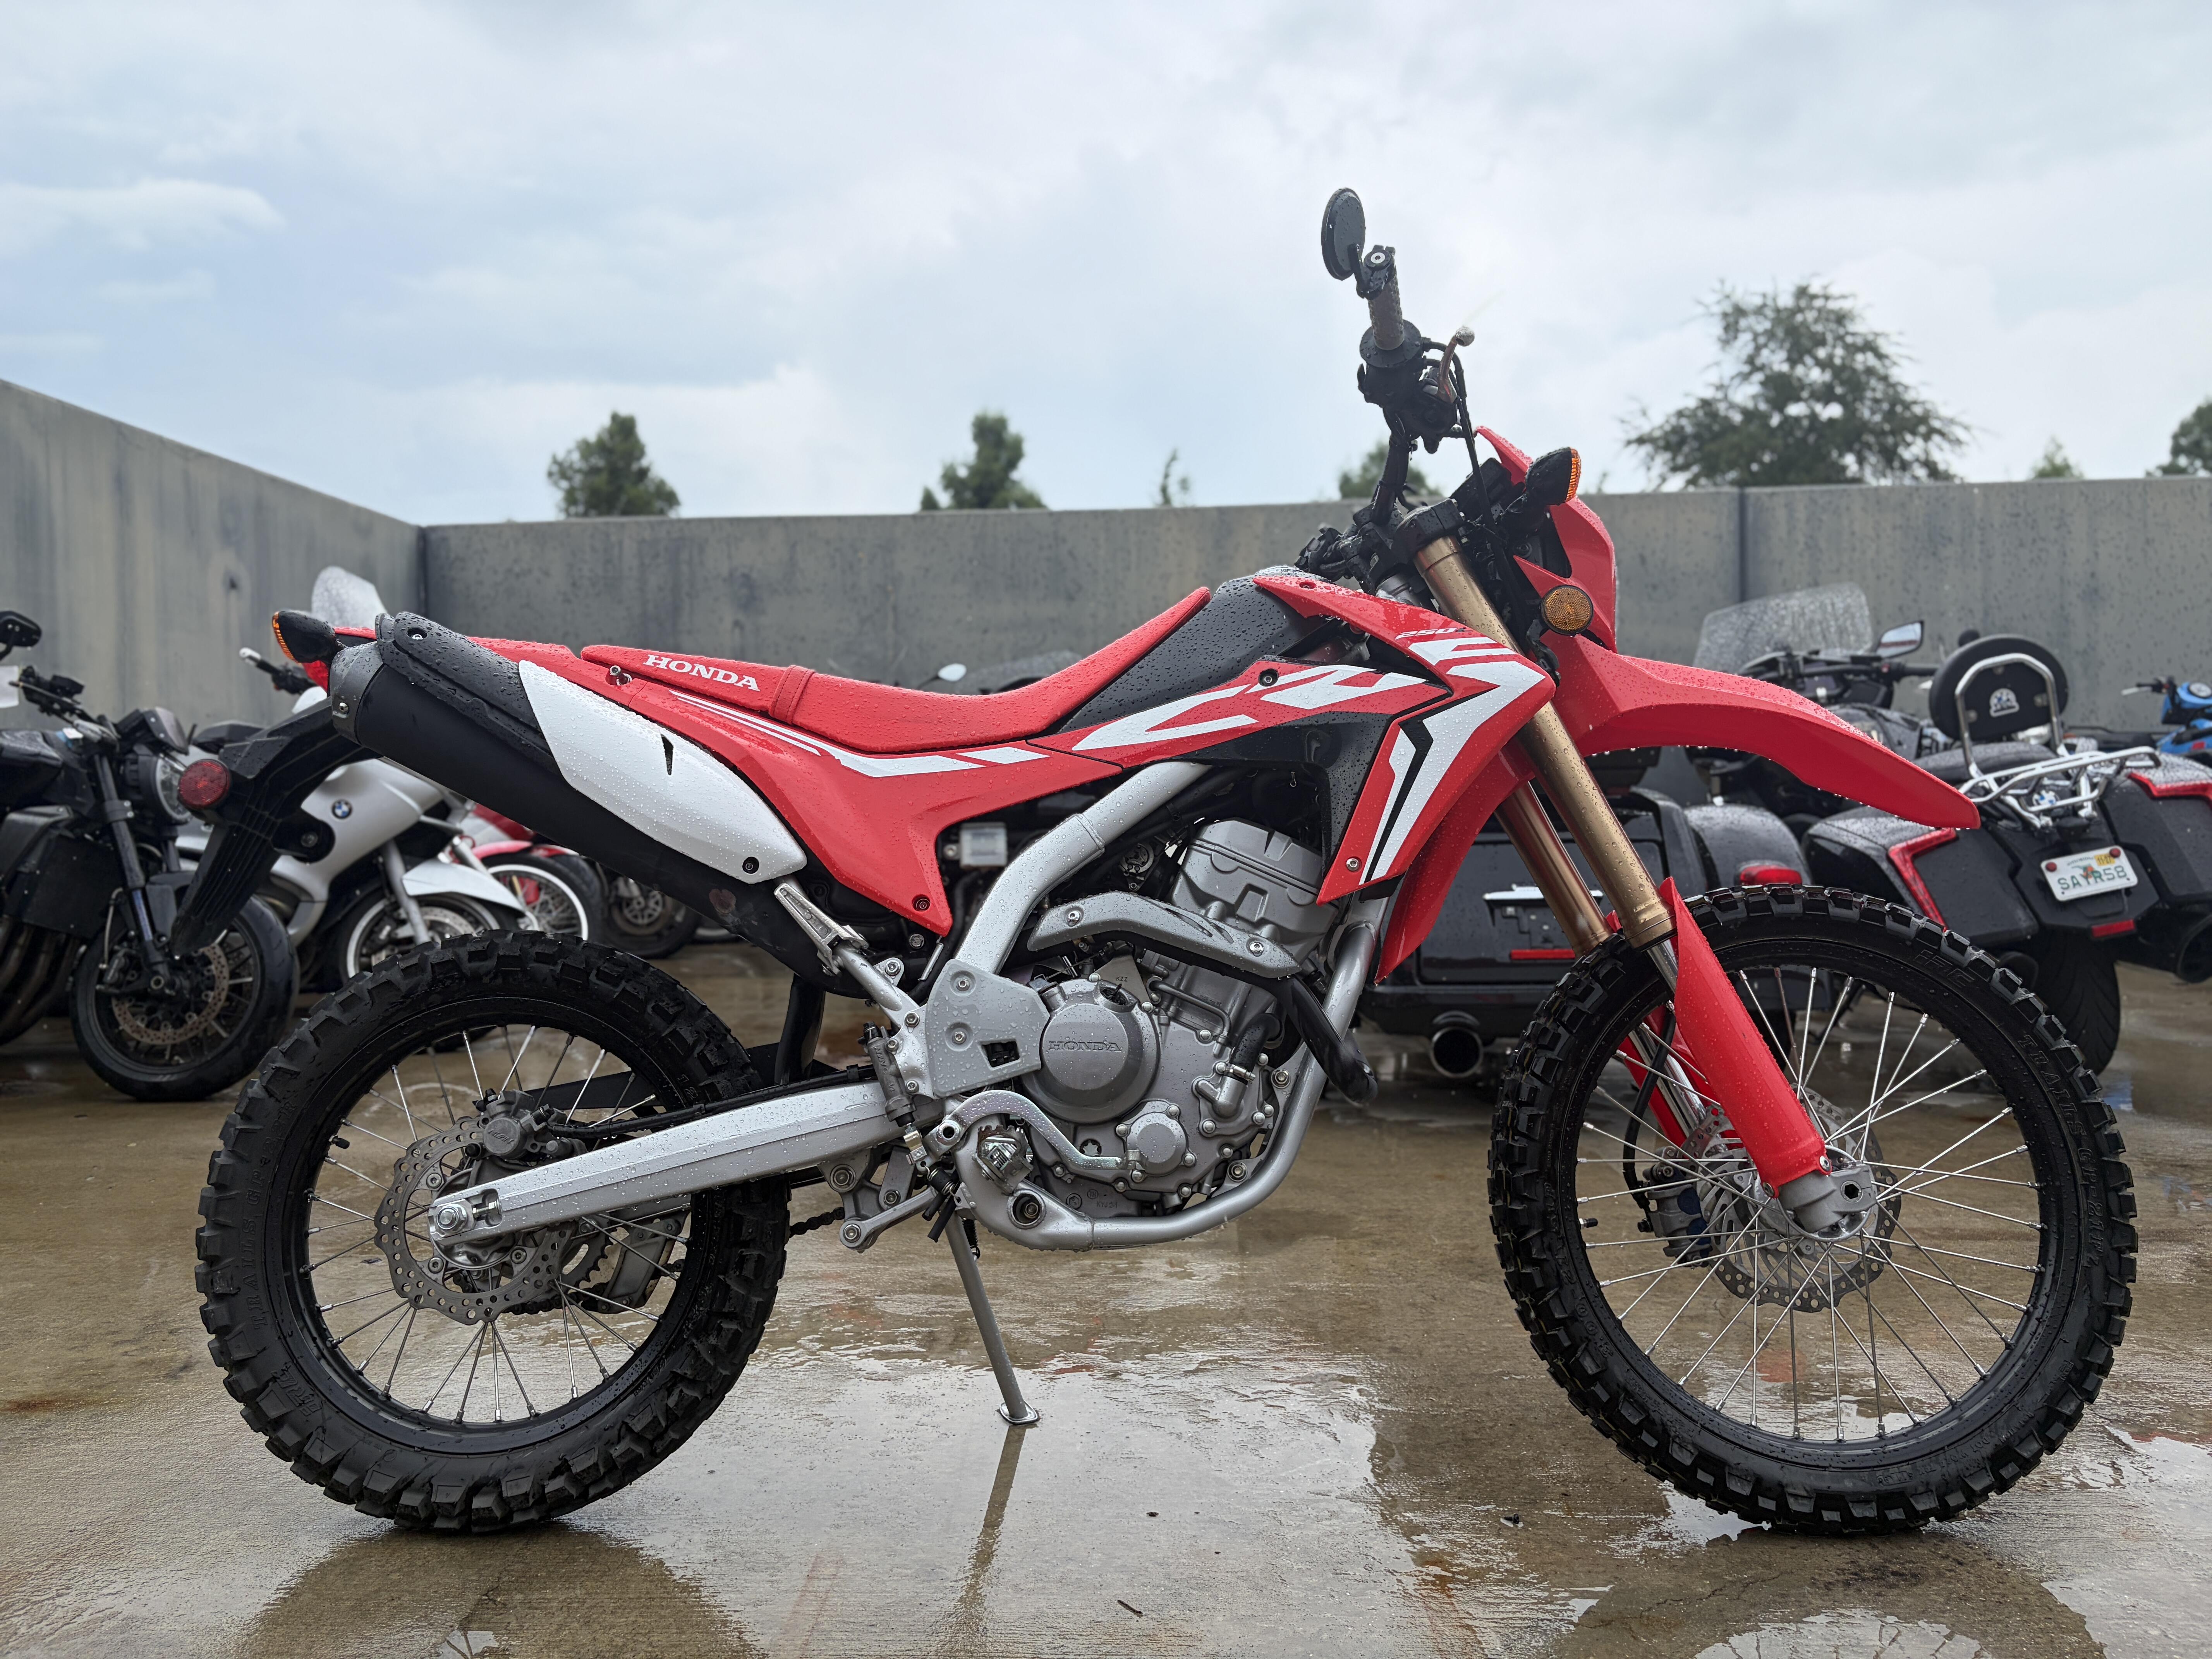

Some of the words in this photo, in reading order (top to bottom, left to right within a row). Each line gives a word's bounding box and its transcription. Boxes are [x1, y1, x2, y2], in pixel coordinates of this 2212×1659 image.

[642, 654, 761, 692] HONDA
[1048, 1041, 1122, 1052] HONDA
[242, 1218, 268, 1329] TRAILS
